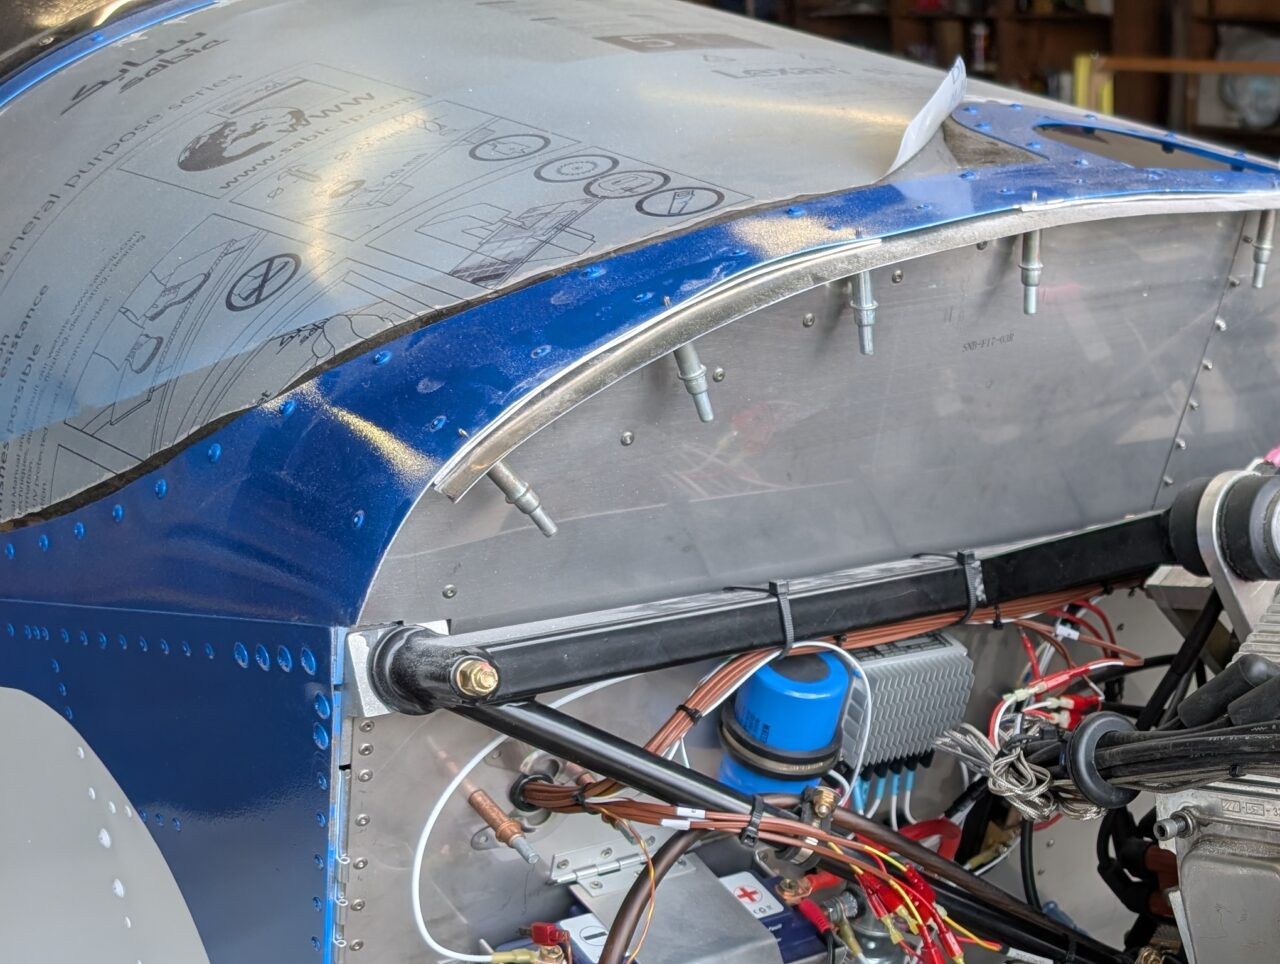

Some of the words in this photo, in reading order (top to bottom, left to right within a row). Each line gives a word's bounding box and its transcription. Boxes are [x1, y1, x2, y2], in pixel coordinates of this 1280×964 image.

[118, 38, 229, 95] sabic
[276, 91, 375, 135] www
[0, 193, 60, 276] eneral
[64, 112, 164, 189] purpose
[168, 73, 243, 111] series
[219, 96, 416, 190] www.sabic-ip.com
[0, 284, 48, 387] esistance
[6, 343, 41, 435] possible
